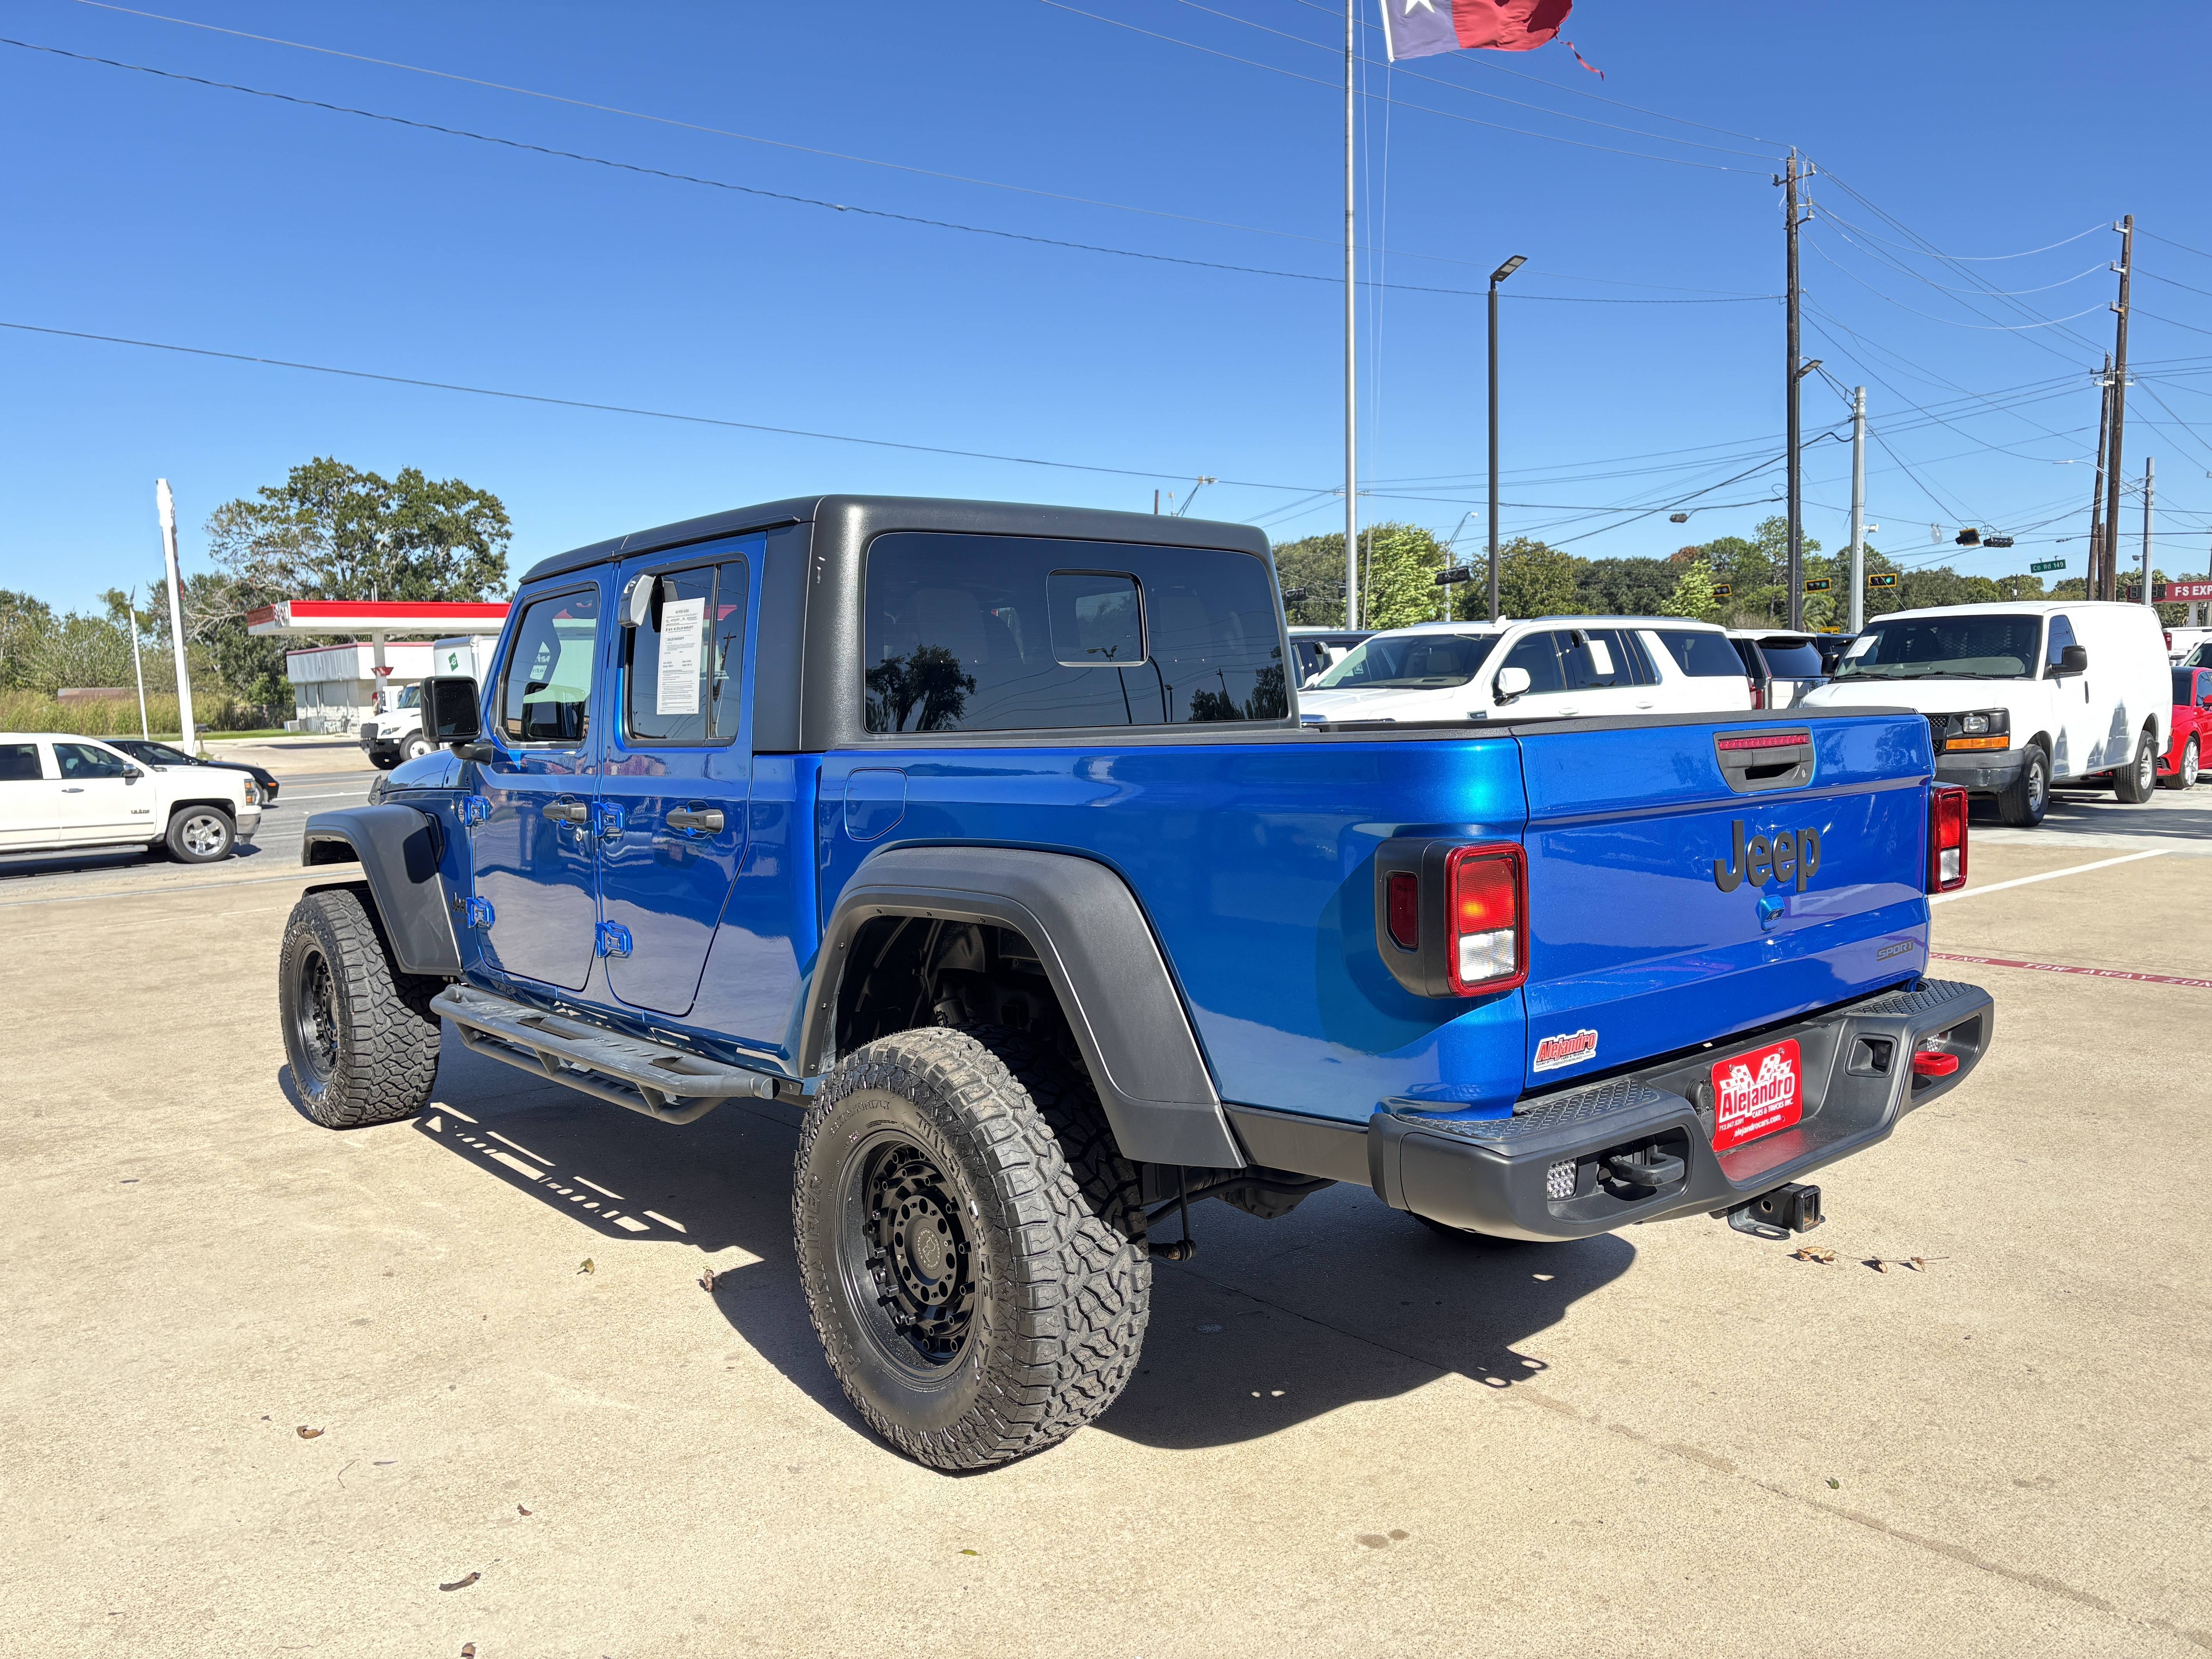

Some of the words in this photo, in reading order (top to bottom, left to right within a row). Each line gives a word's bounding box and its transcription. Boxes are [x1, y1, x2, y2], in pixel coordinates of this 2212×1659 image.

[2175, 586, 2189, 597] FS
[1714, 820, 1821, 893] Jeep
[1877, 941, 1914, 960] SPORT
[2023, 963, 2073, 971] TOW
[2078, 969, 2156, 980] AWAY
[1537, 1032, 1596, 1061] Alejandro
[1721, 1075, 1793, 1118] Alejandro
[1752, 1109, 1763, 1118] CARS
[1768, 1101, 1784, 1113] TRUCKS
[1734, 1114, 1781, 1137] alejandrocars.com
